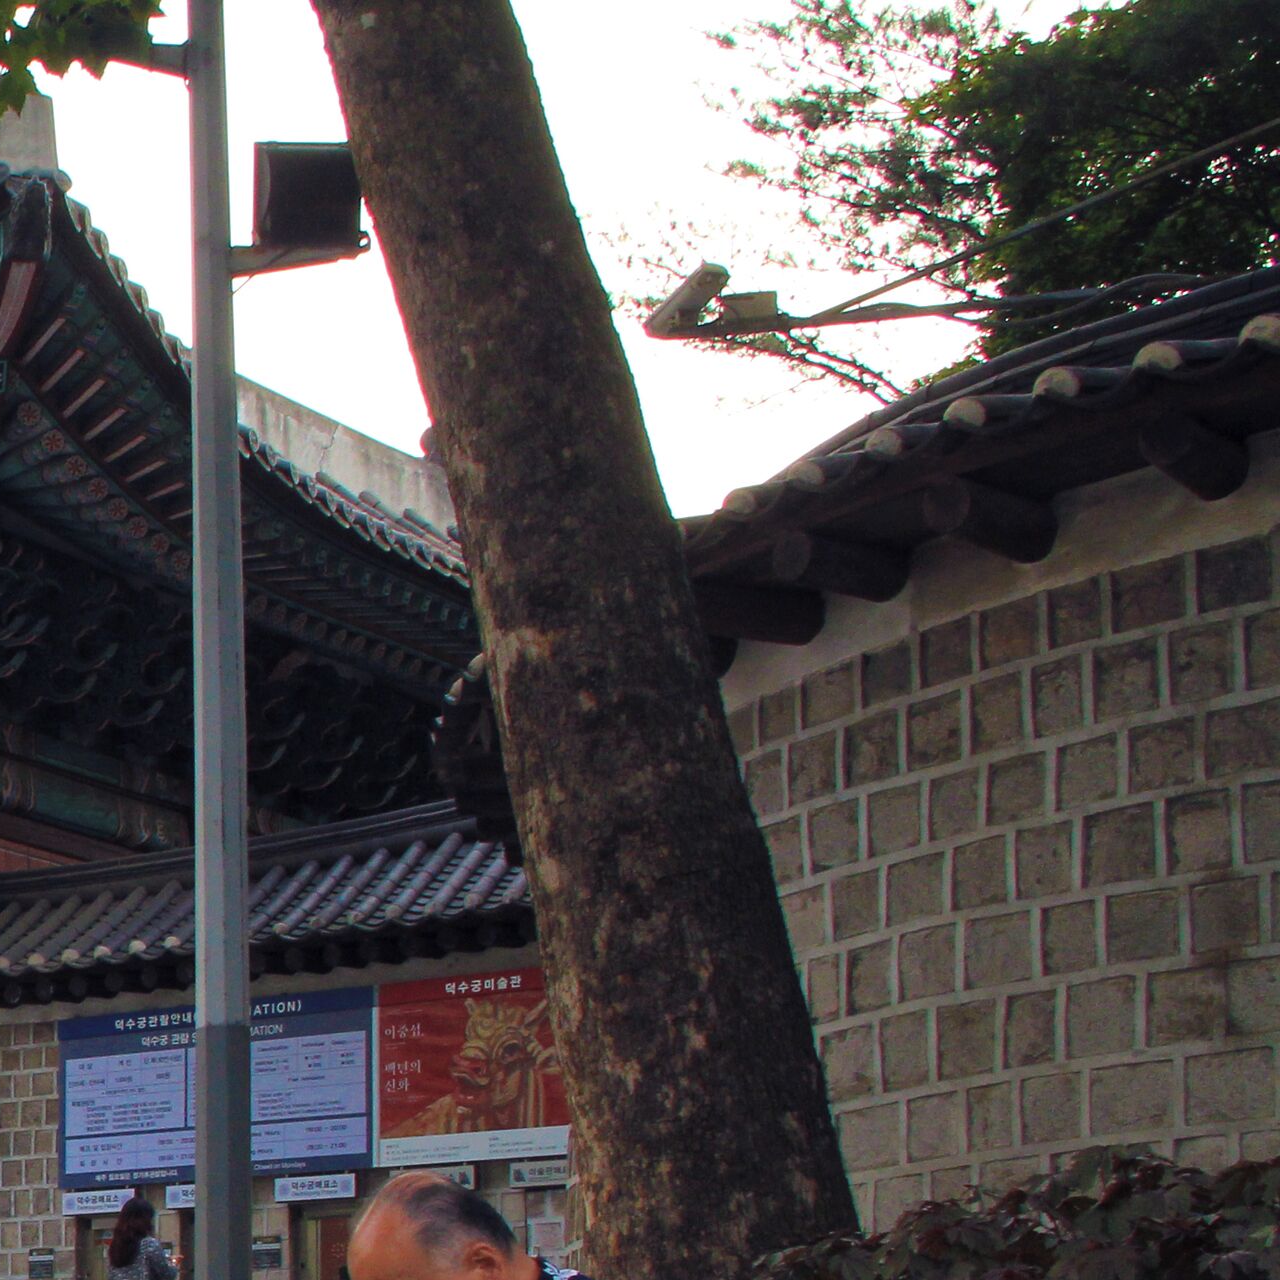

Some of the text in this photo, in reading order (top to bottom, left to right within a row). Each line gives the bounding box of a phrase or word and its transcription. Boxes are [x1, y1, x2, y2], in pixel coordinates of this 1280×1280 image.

[445, 976, 522, 995] 덕수궁미술관
[249, 1000, 302, 1016] ATION)
[141, 1034, 168, 1046] 덕수궁
[384, 1078, 410, 1093] 신화
[291, 1180, 338, 1190] 덕수궁매표소
